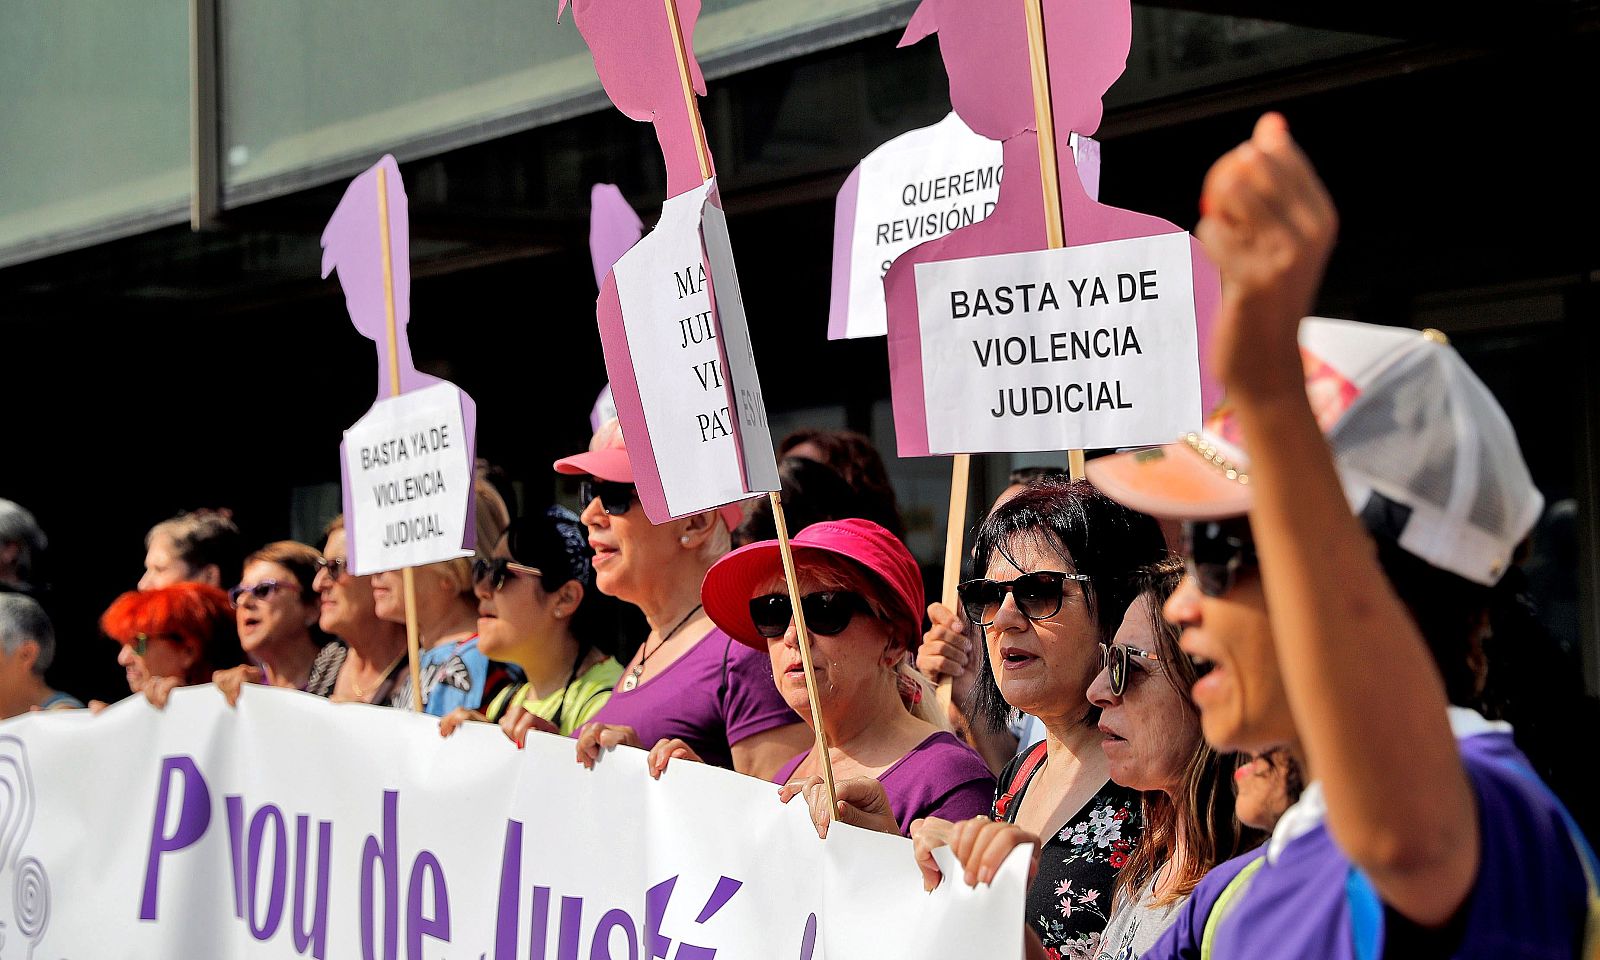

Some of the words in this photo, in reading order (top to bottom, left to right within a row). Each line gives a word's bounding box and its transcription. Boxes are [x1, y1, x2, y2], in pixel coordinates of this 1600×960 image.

[876, 203, 975, 246] REVISIÓN
[950, 283, 1059, 319] BASTA
[1068, 277, 1109, 308] YA
[1117, 269, 1159, 304] DE
[973, 325, 1142, 367] VIOLENCIA
[991, 380, 1133, 418] JUDICIAL
[360, 438, 409, 470] BASTA
[411, 432, 430, 457] YA
[430, 425, 450, 451] DE
[372, 470, 447, 508] VIOLENCIA
[382, 513, 446, 548] JUDICIAL
[360, 790, 451, 960] de
